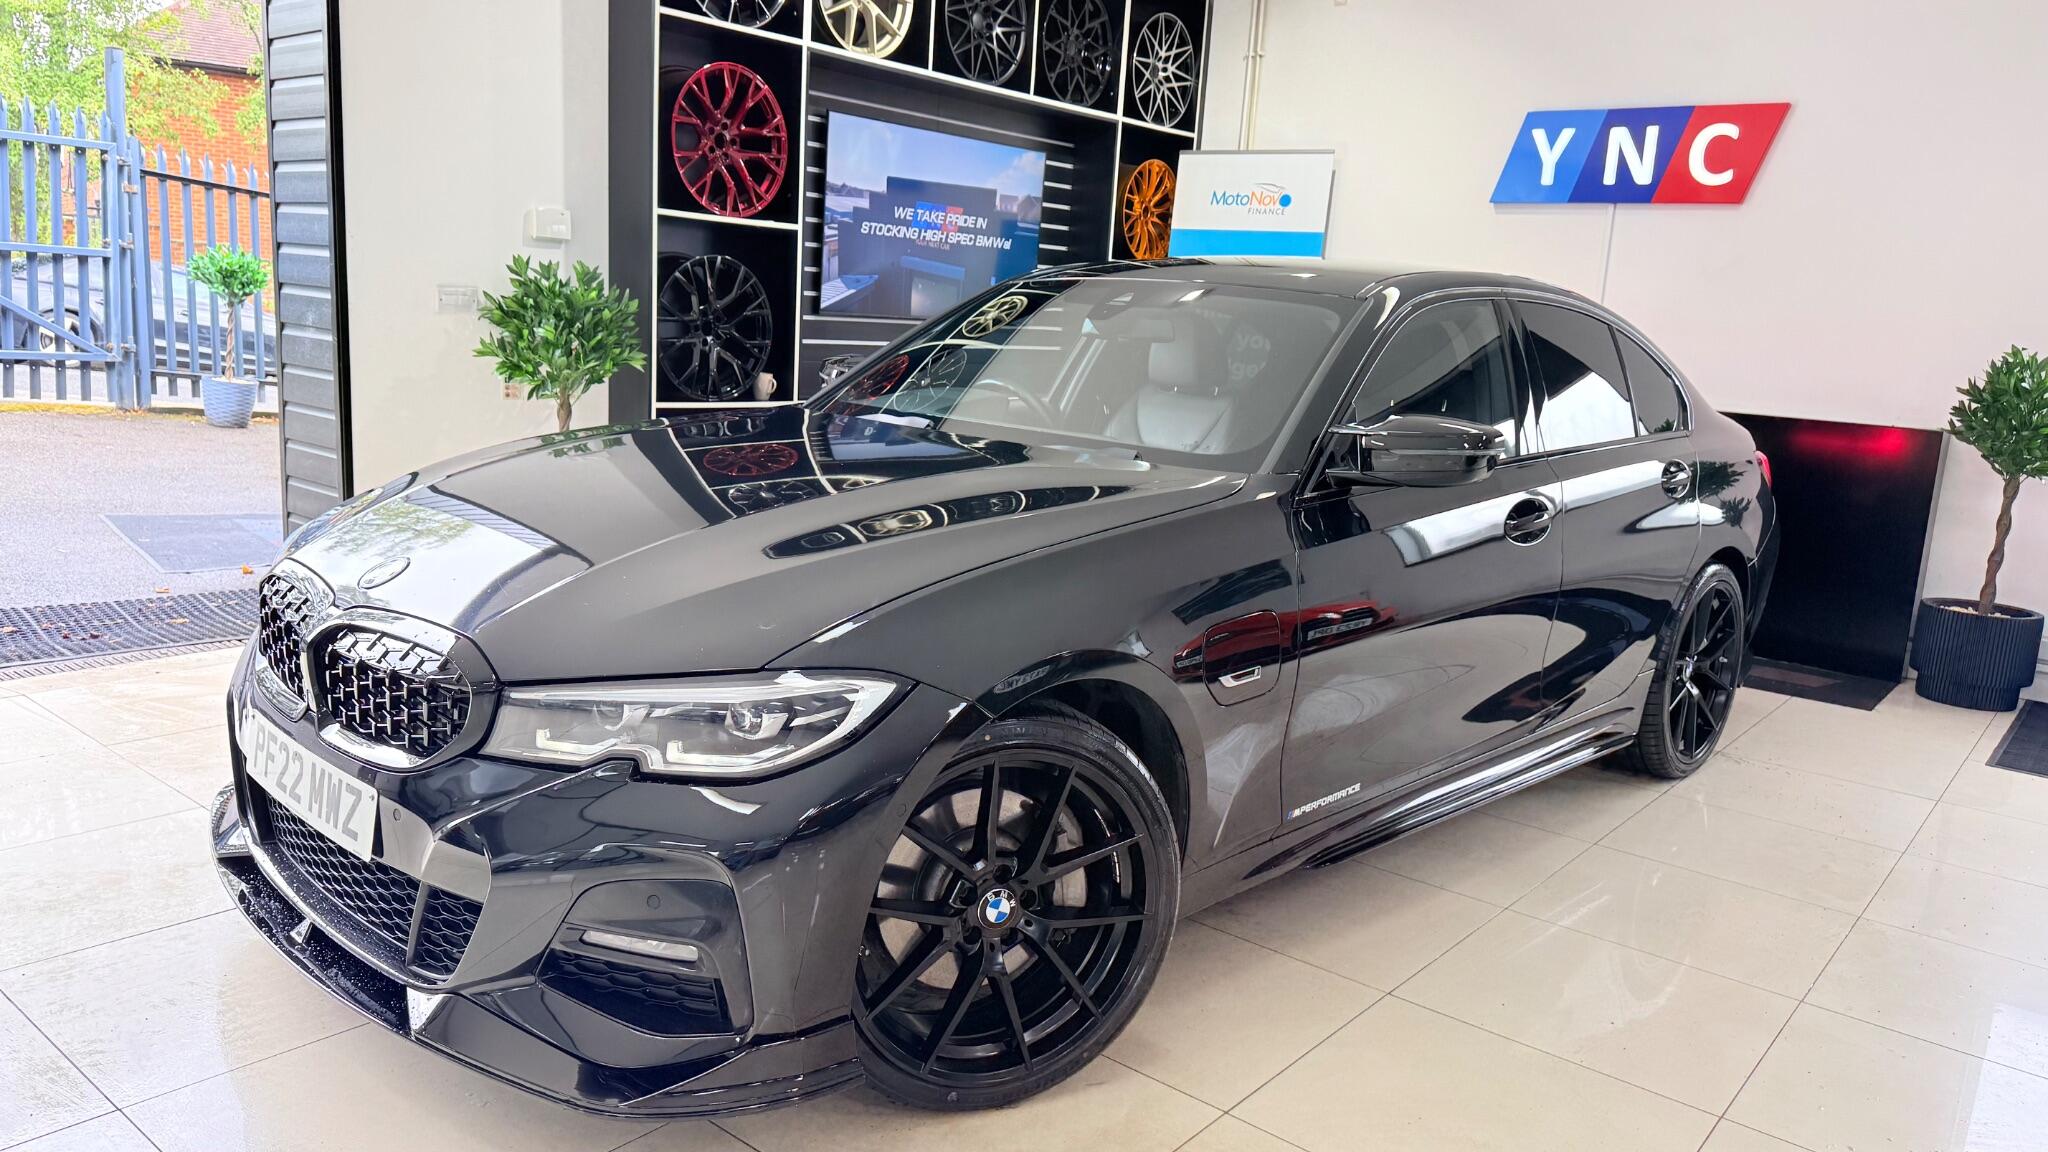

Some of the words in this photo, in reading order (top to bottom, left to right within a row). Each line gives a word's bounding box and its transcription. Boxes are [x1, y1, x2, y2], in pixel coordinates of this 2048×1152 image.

[1531, 122, 1740, 187] YNC
[1210, 190, 1292, 207] MotoNovo
[894, 206, 915, 221] WE
[916, 209, 946, 225] TAKE
[945, 213, 977, 229] PRIDE
[976, 217, 988, 230] IN
[1247, 208, 1286, 216] FINANCE
[860, 221, 919, 240] STOCKING
[920, 229, 946, 243] HIGH
[947, 231, 974, 246] SPEC
[253, 723, 304, 805] PF22
[307, 762, 363, 842] MWZ
